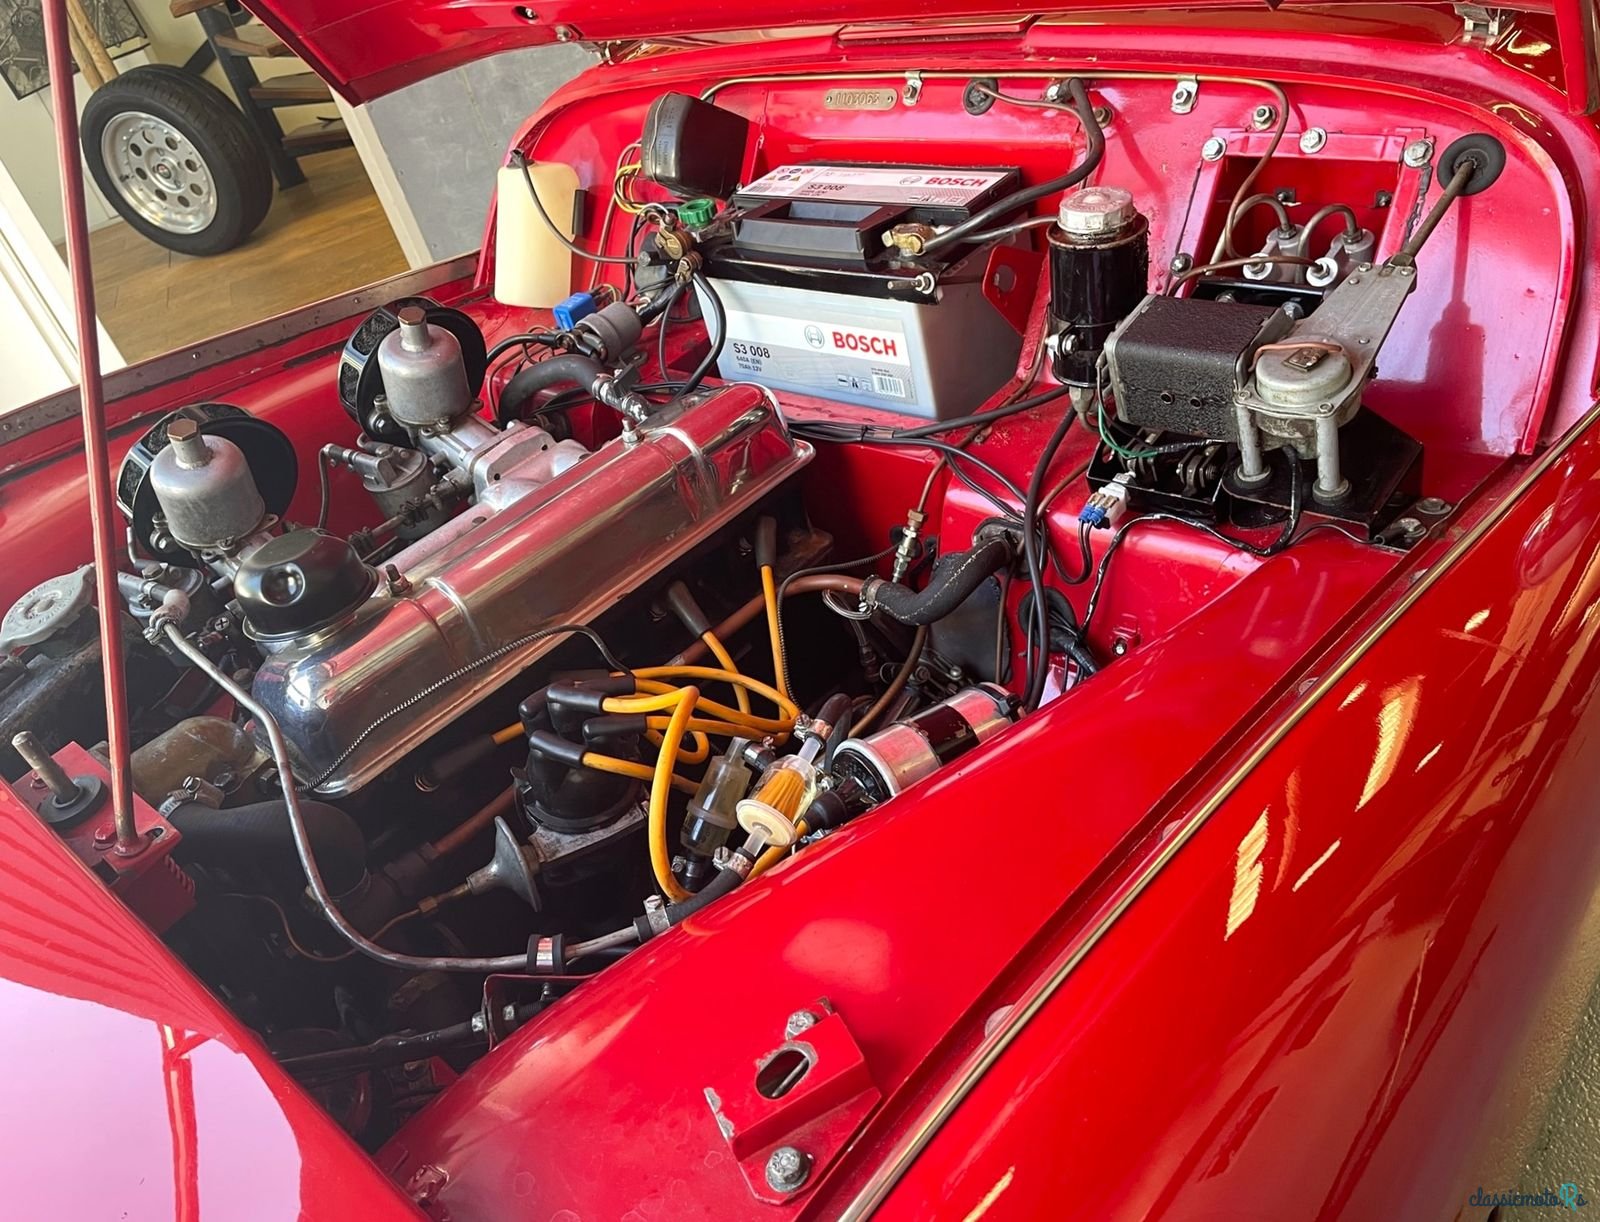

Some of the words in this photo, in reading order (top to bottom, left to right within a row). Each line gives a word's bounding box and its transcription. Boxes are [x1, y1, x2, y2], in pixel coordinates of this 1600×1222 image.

[925, 176, 988, 187] BOSCH
[733, 342, 747, 354] S3
[749, 345, 770, 358] 008
[832, 331, 897, 357] BOSCH
